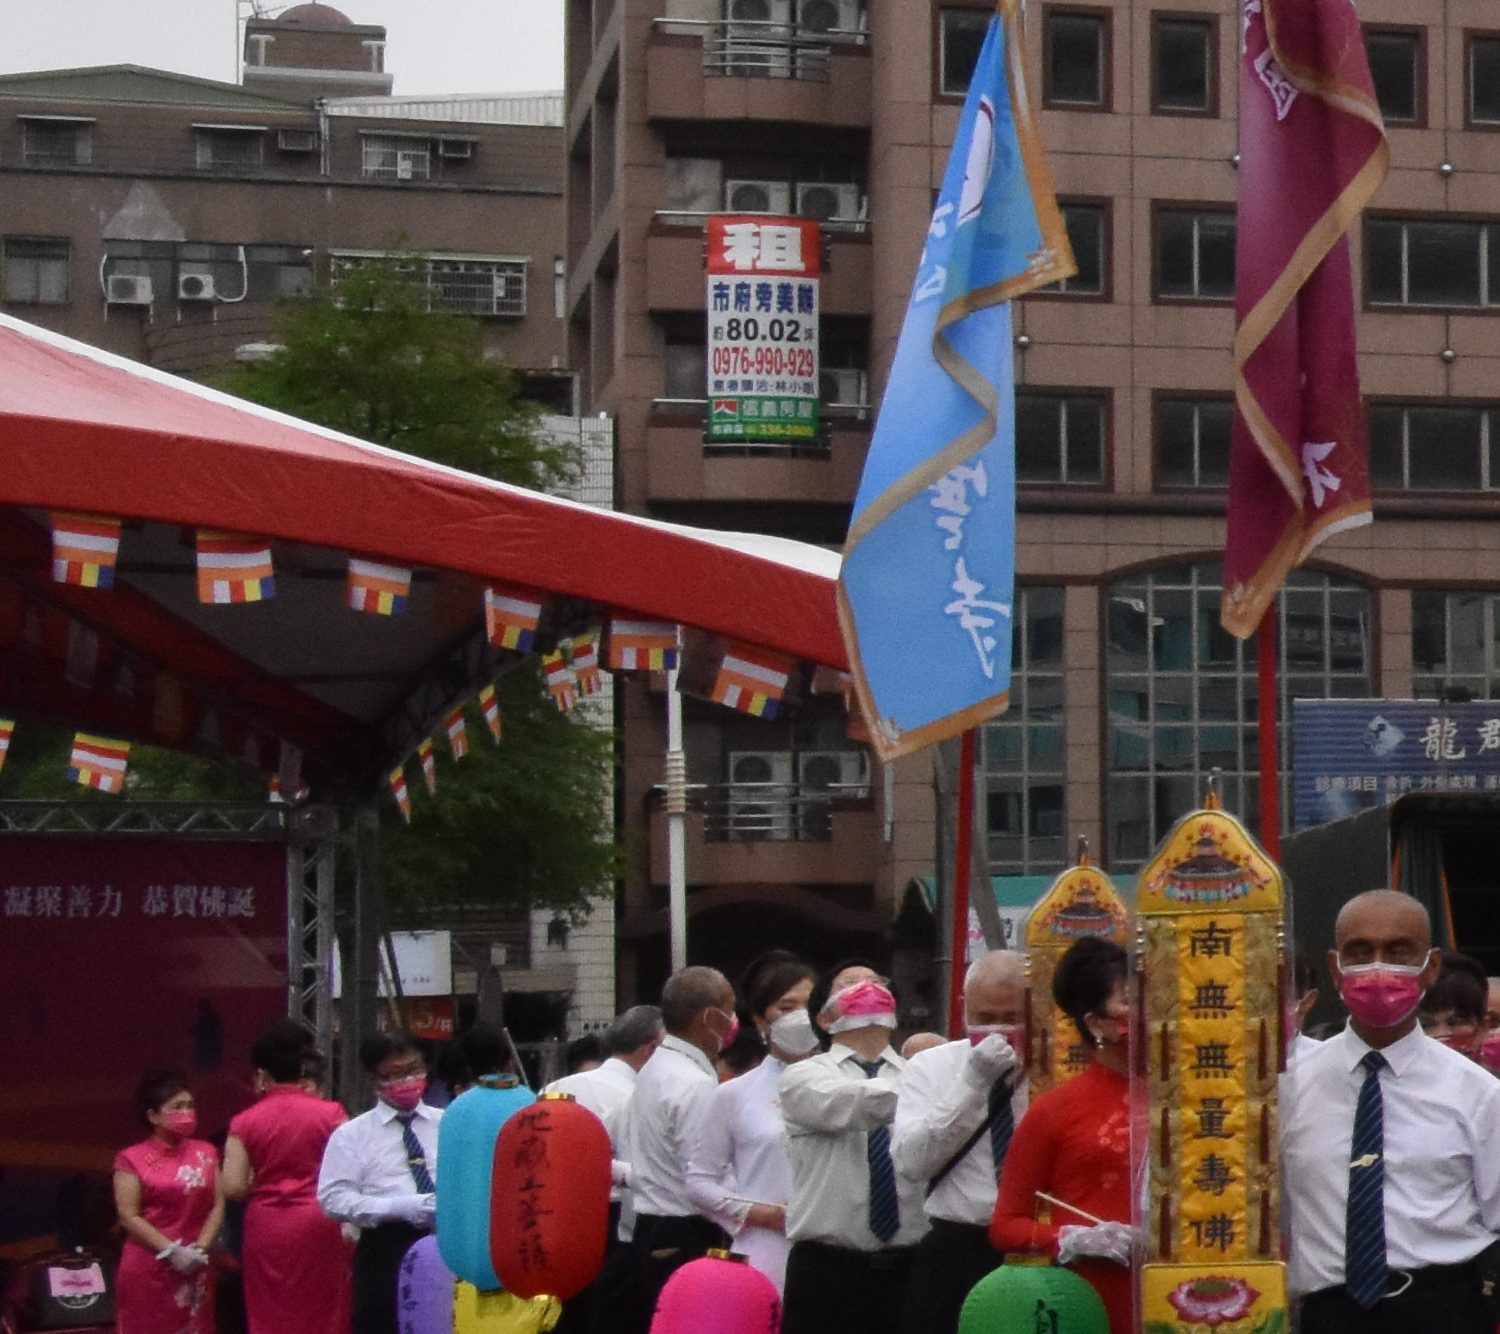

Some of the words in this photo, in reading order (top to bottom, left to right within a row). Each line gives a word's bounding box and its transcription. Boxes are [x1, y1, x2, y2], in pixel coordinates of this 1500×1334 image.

[722, 222, 807, 272] 租
[713, 346, 814, 378] 0976-990-929
[3, 885, 123, 920] 凝聚善力
[142, 884, 256, 920] 恭賀佛誕
